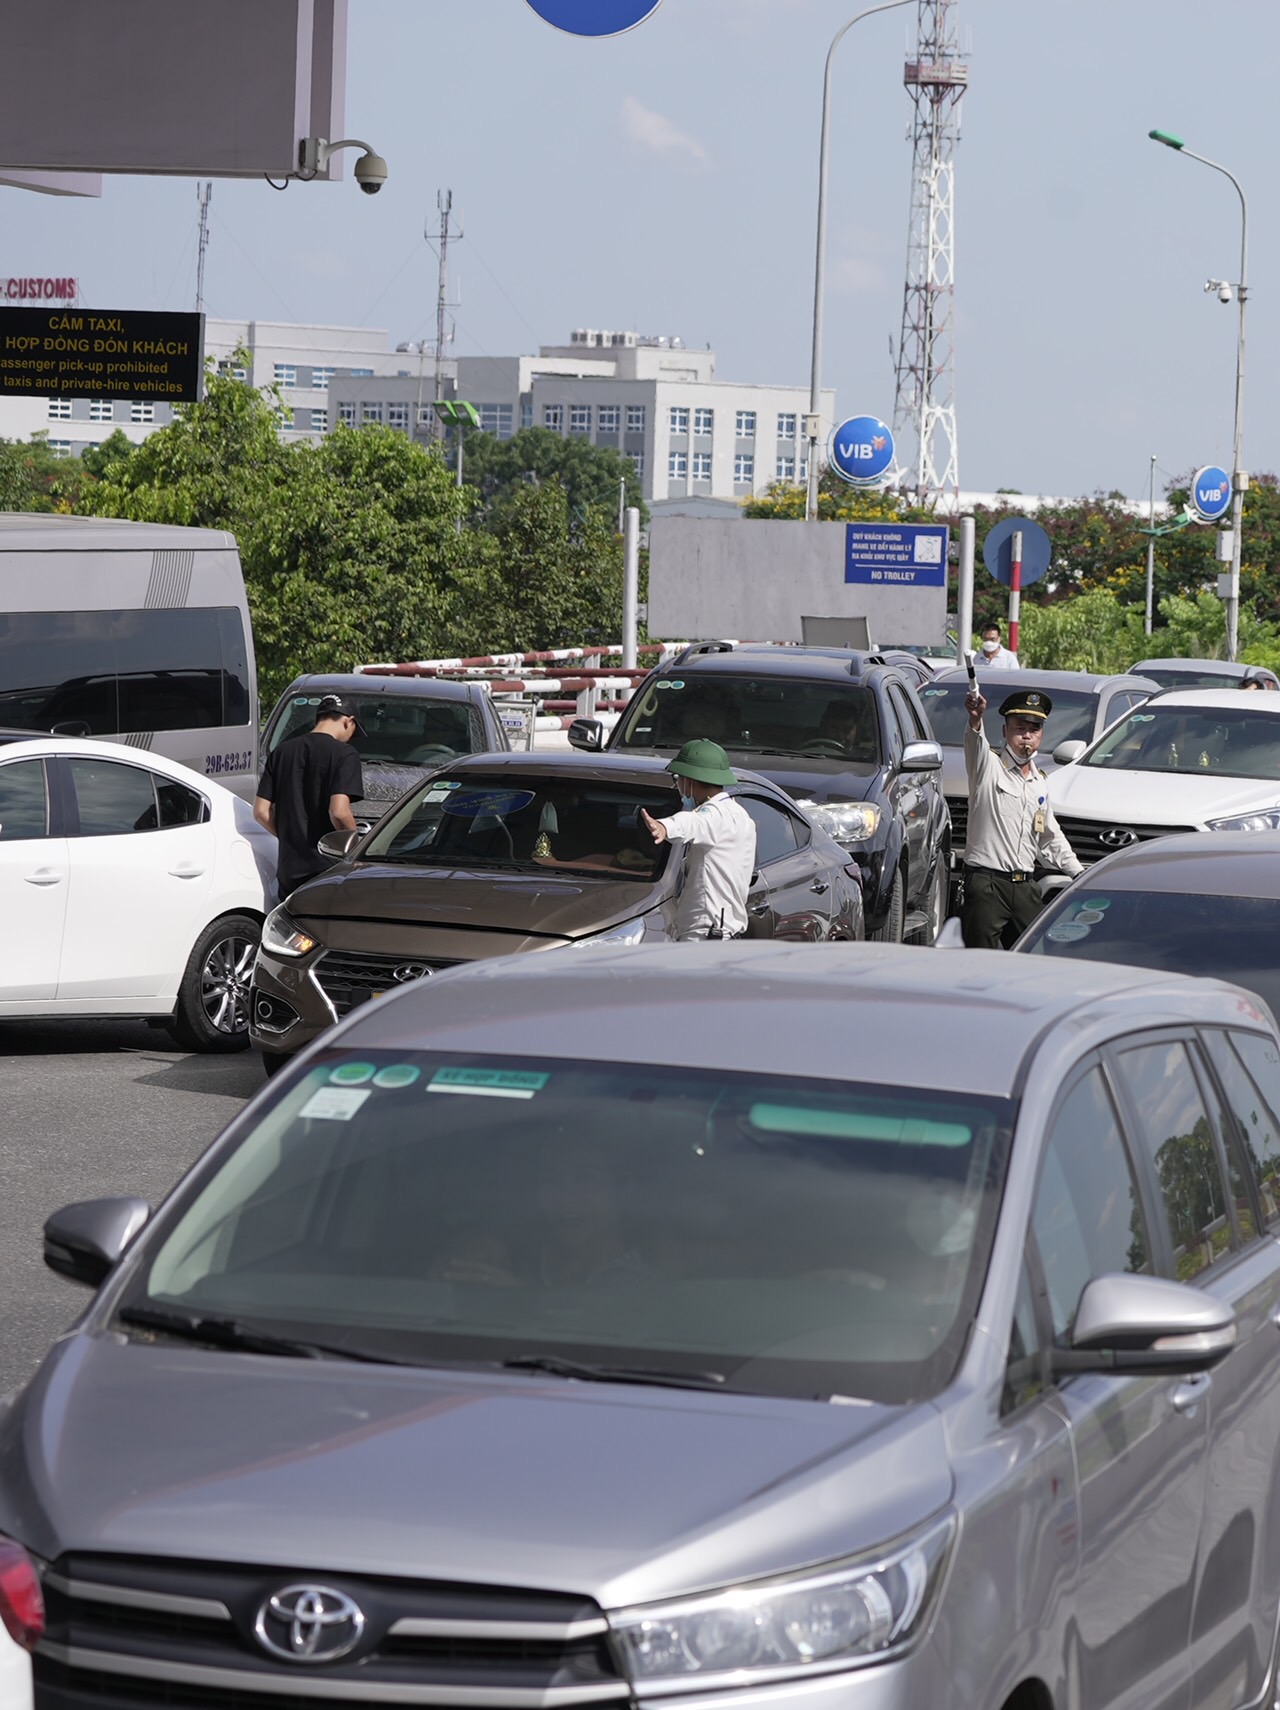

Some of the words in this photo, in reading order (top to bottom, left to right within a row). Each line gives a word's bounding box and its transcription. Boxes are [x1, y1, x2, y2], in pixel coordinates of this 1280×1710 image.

[88, 317, 125, 333] TAXI,
[5, 336, 40, 352] HỢP
[43, 335, 90, 352] ĐỒNG
[94, 336, 128, 353] ĐÓN
[132, 338, 188, 355] KHÁCH
[0, 359, 56, 372] assenger
[59, 359, 104, 374] pick-up
[107, 362, 168, 375] prohibited
[4, 375, 32, 388] taxis
[35, 376, 58, 388] and
[61, 377, 130, 391] private-hire
[133, 380, 183, 393] vehicles
[839, 443, 874, 459] VIB
[1199, 489, 1222, 502] VIB
[871, 570, 882, 580] NO
[883, 571, 916, 581] TROLLEY
[205, 750, 252, 774] 29B-623.37
